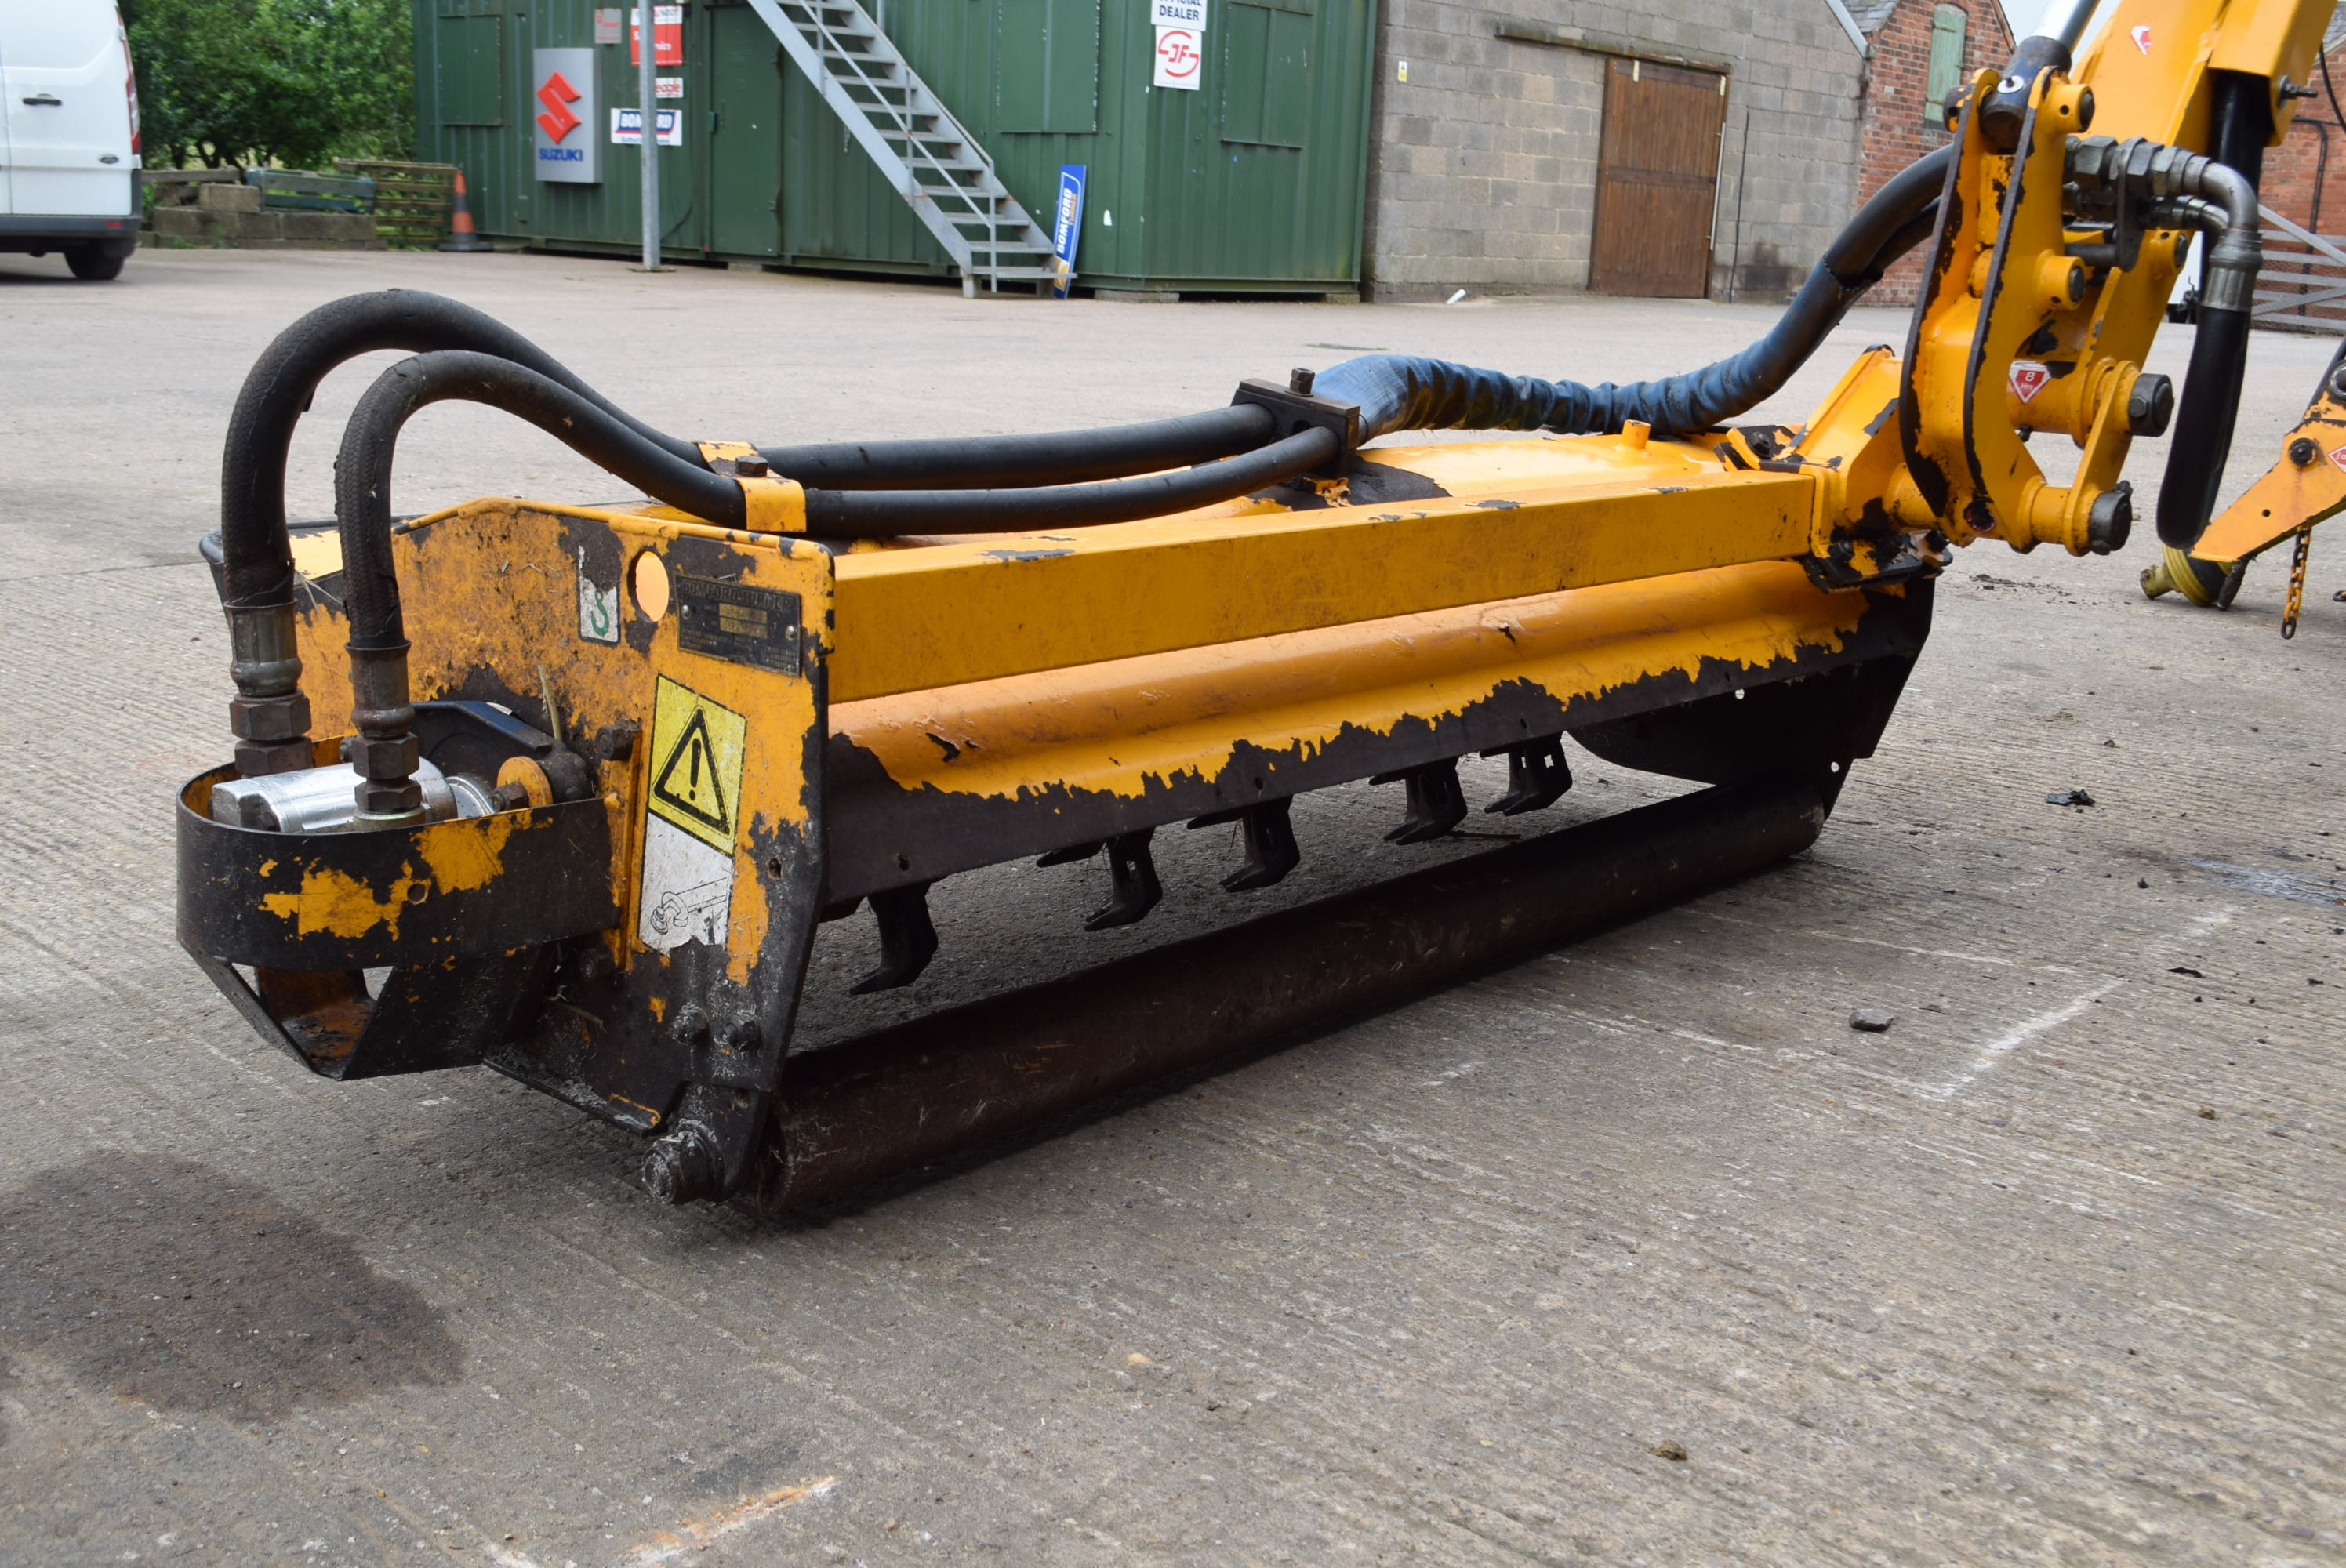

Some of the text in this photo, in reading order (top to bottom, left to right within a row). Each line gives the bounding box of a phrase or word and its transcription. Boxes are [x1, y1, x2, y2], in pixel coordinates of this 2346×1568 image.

[1159, 5, 1200, 20] DEALER
[539, 148, 583, 162] SUZUKI
[1056, 187, 1073, 255] BOMFORD
[2025, 372, 2036, 382] 8
